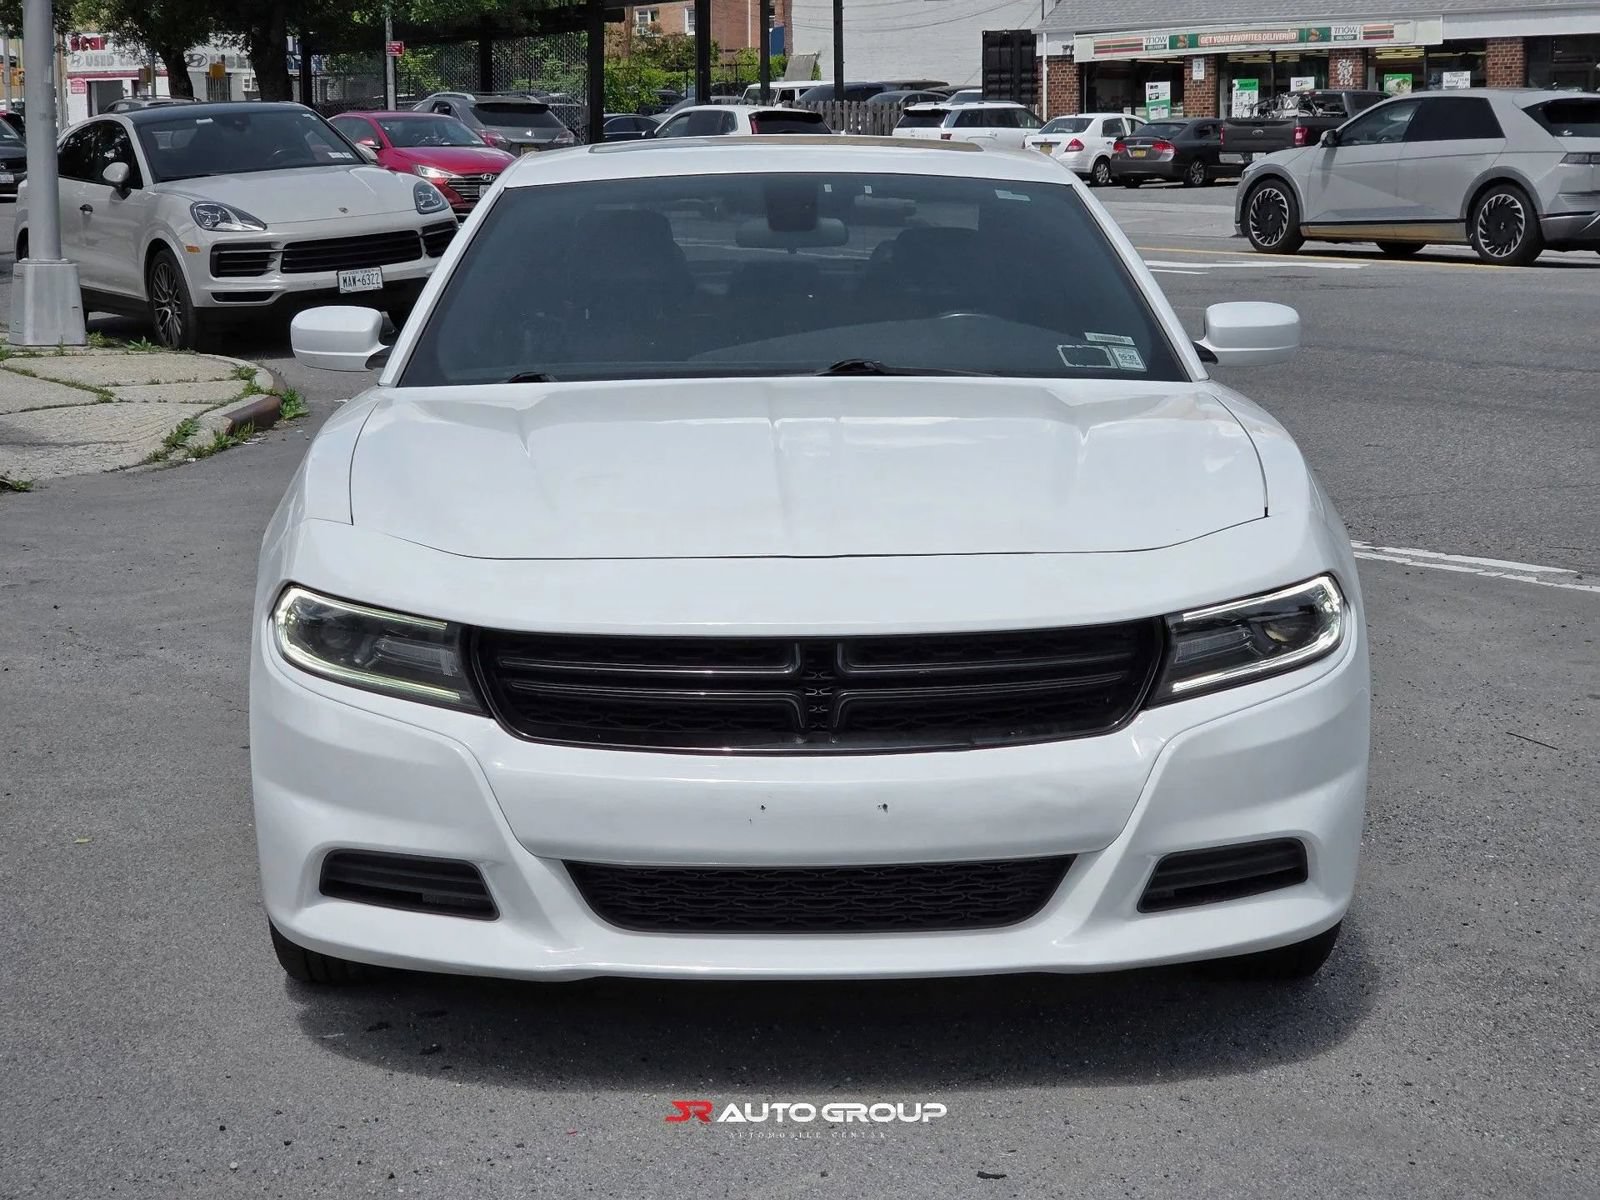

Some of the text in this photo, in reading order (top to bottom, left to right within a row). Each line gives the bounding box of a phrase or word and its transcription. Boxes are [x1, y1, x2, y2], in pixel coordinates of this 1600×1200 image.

[1230, 32, 1262, 42] FAVORITES
[1262, 32, 1297, 41] DELIVERED
[85, 54, 115, 67] USED
